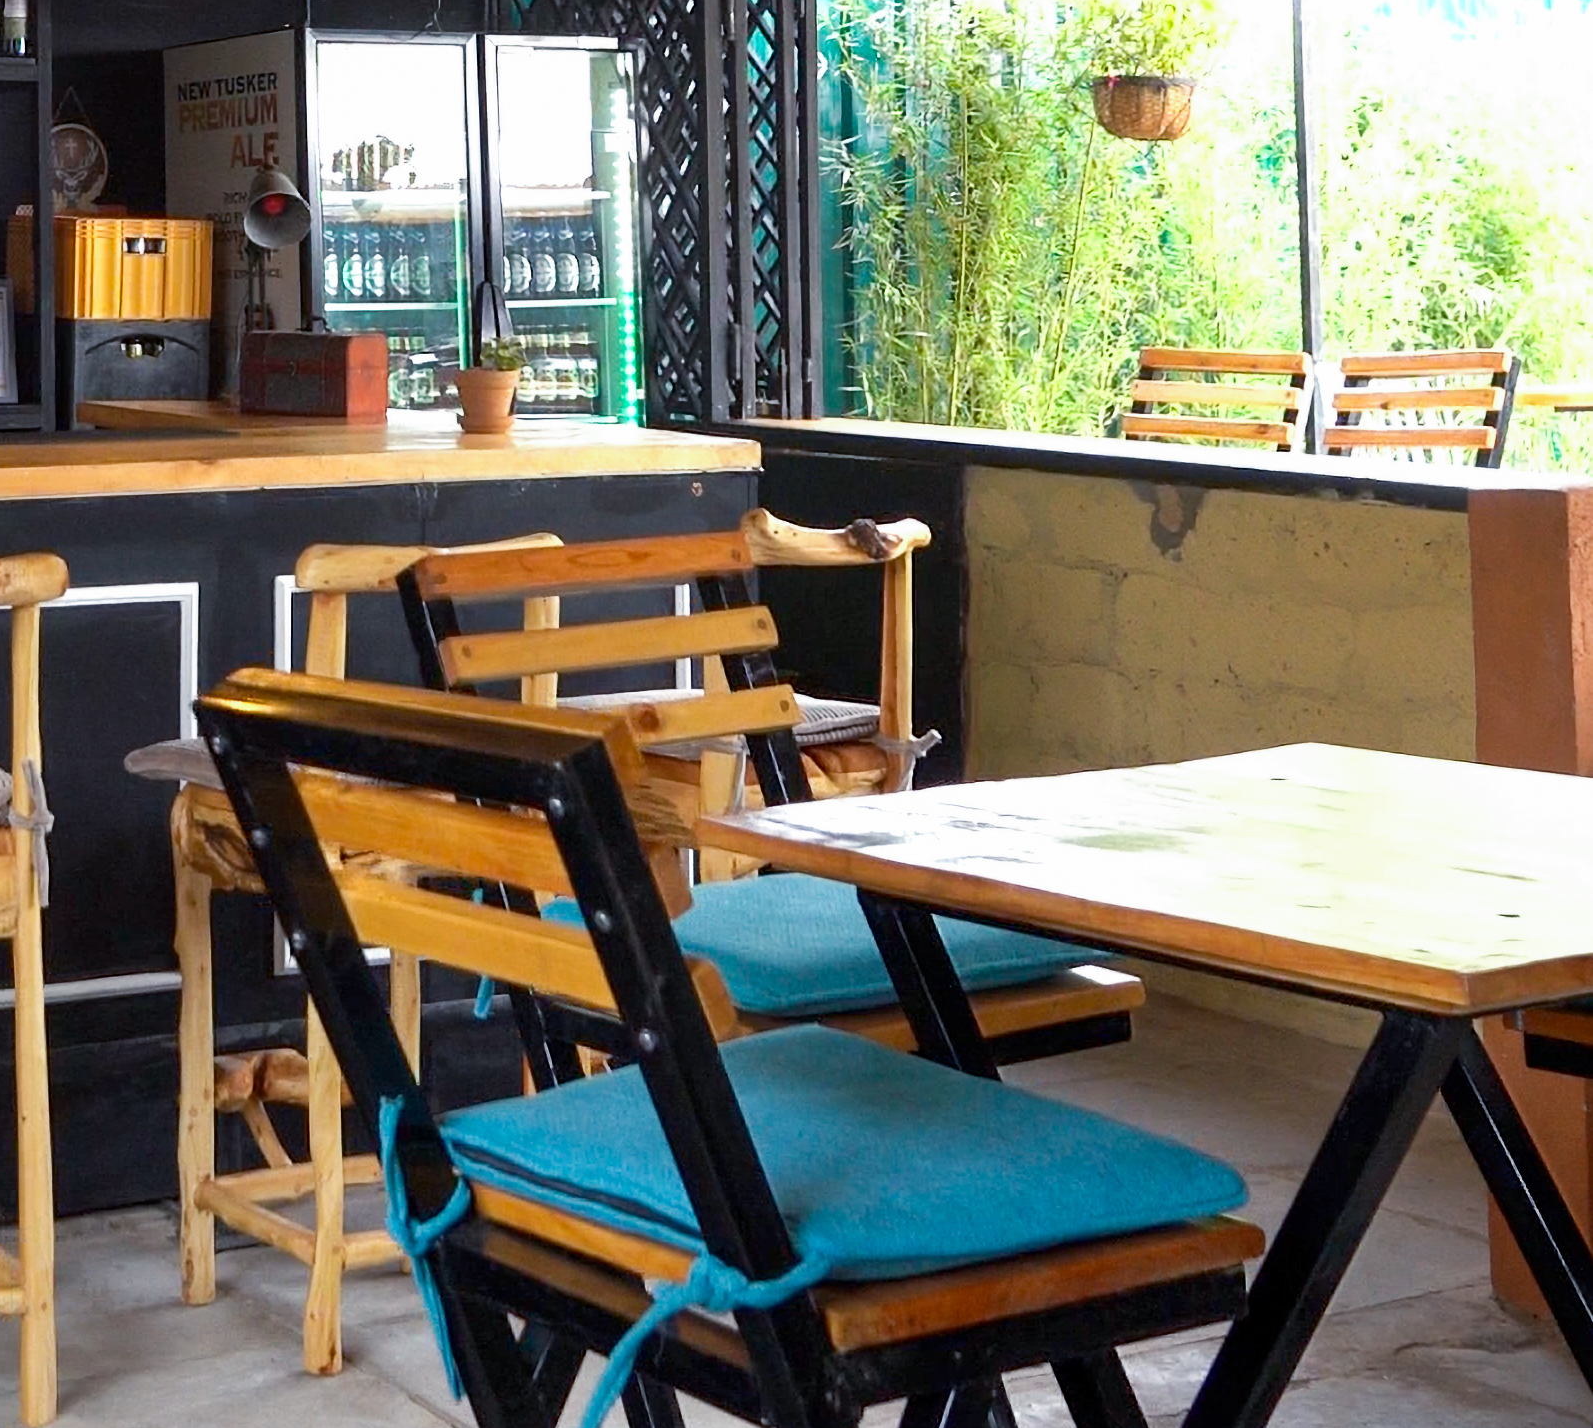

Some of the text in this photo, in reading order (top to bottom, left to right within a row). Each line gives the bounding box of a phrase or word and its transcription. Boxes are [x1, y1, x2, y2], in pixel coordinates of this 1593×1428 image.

[177, 72, 278, 102] NEW TUSKER
[178, 92, 279, 133] PREMIUM
[230, 131, 280, 170] ALE
